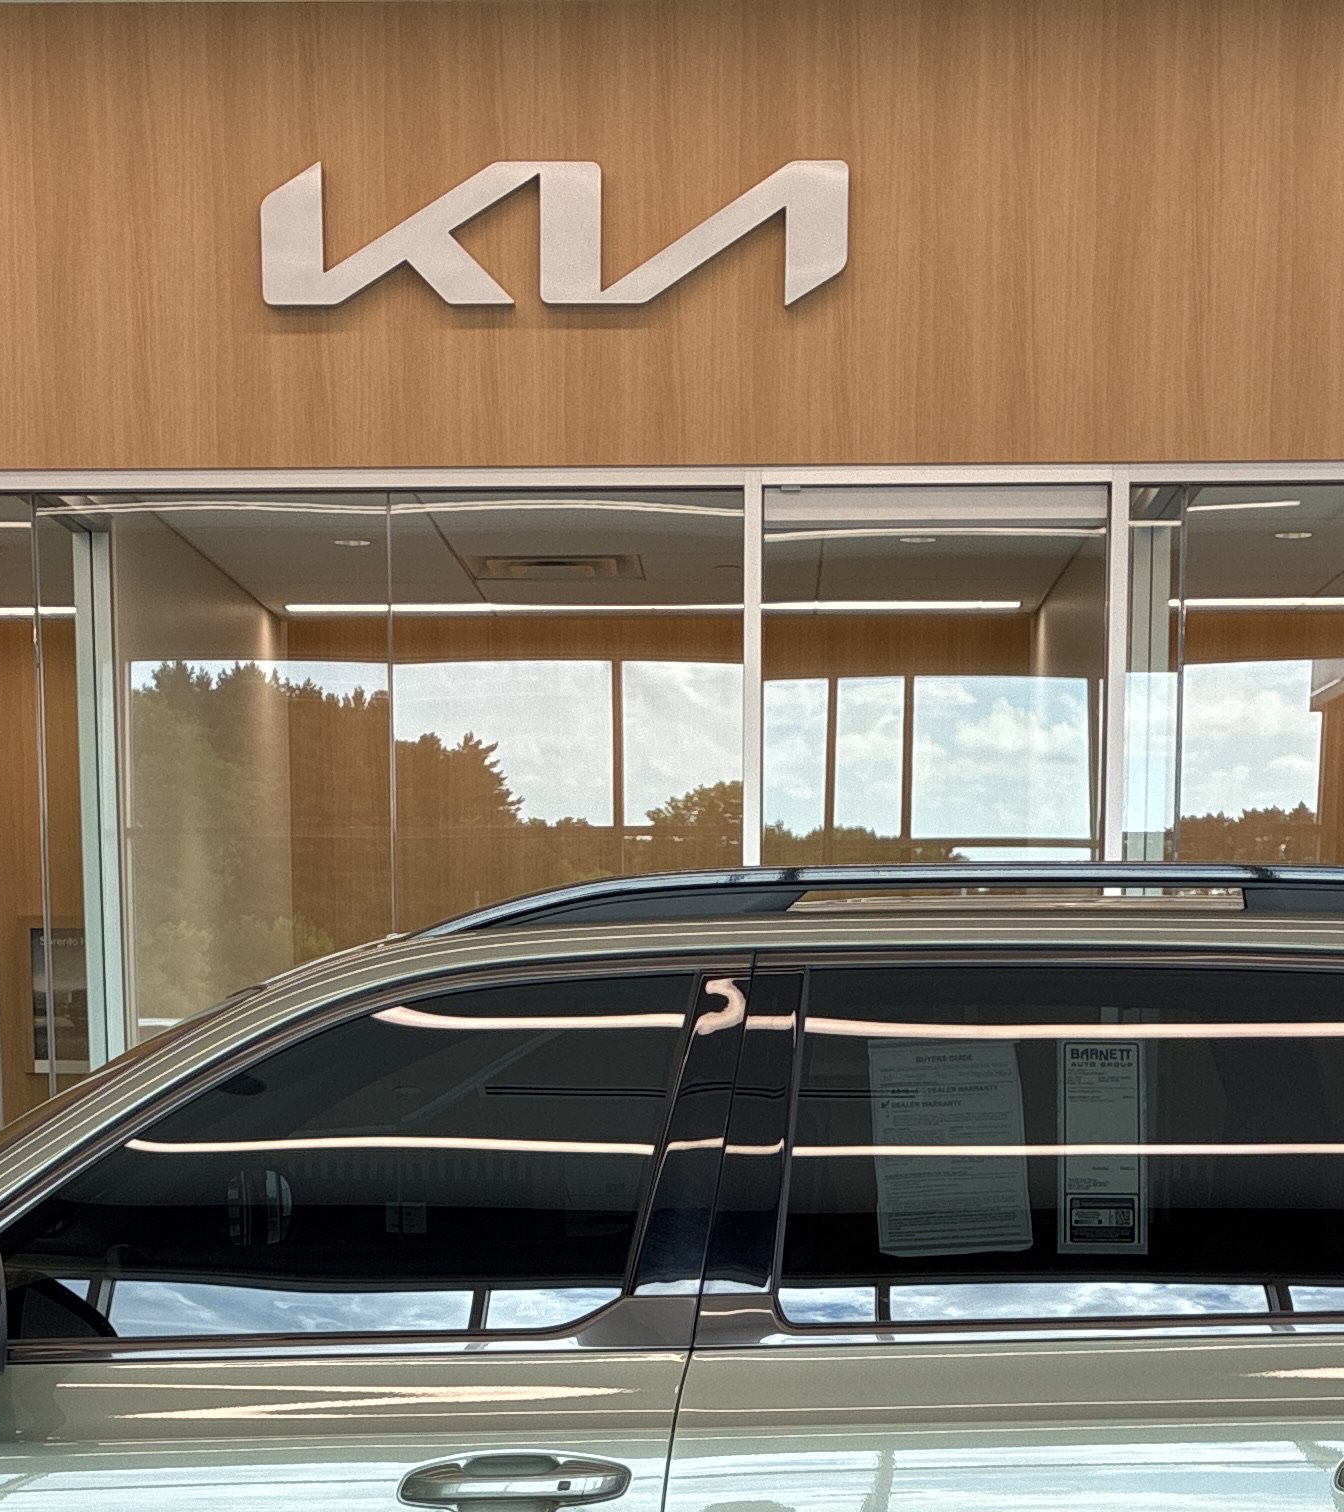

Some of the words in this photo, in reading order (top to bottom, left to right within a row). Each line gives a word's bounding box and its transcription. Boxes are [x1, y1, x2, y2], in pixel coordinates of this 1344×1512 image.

[260, 160, 849, 307] KIA
[39, 935, 79, 947] Srento
[915, 1054, 947, 1064] BUYERS
[949, 1053, 973, 1062] GUIDE
[1071, 1048, 1132, 1061] BARNETT
[927, 1086, 958, 1095] DEALER
[958, 1085, 998, 1094] WARRANTY
[891, 1100, 920, 1110] DEALER
[922, 1099, 963, 1109] WARRANTY
